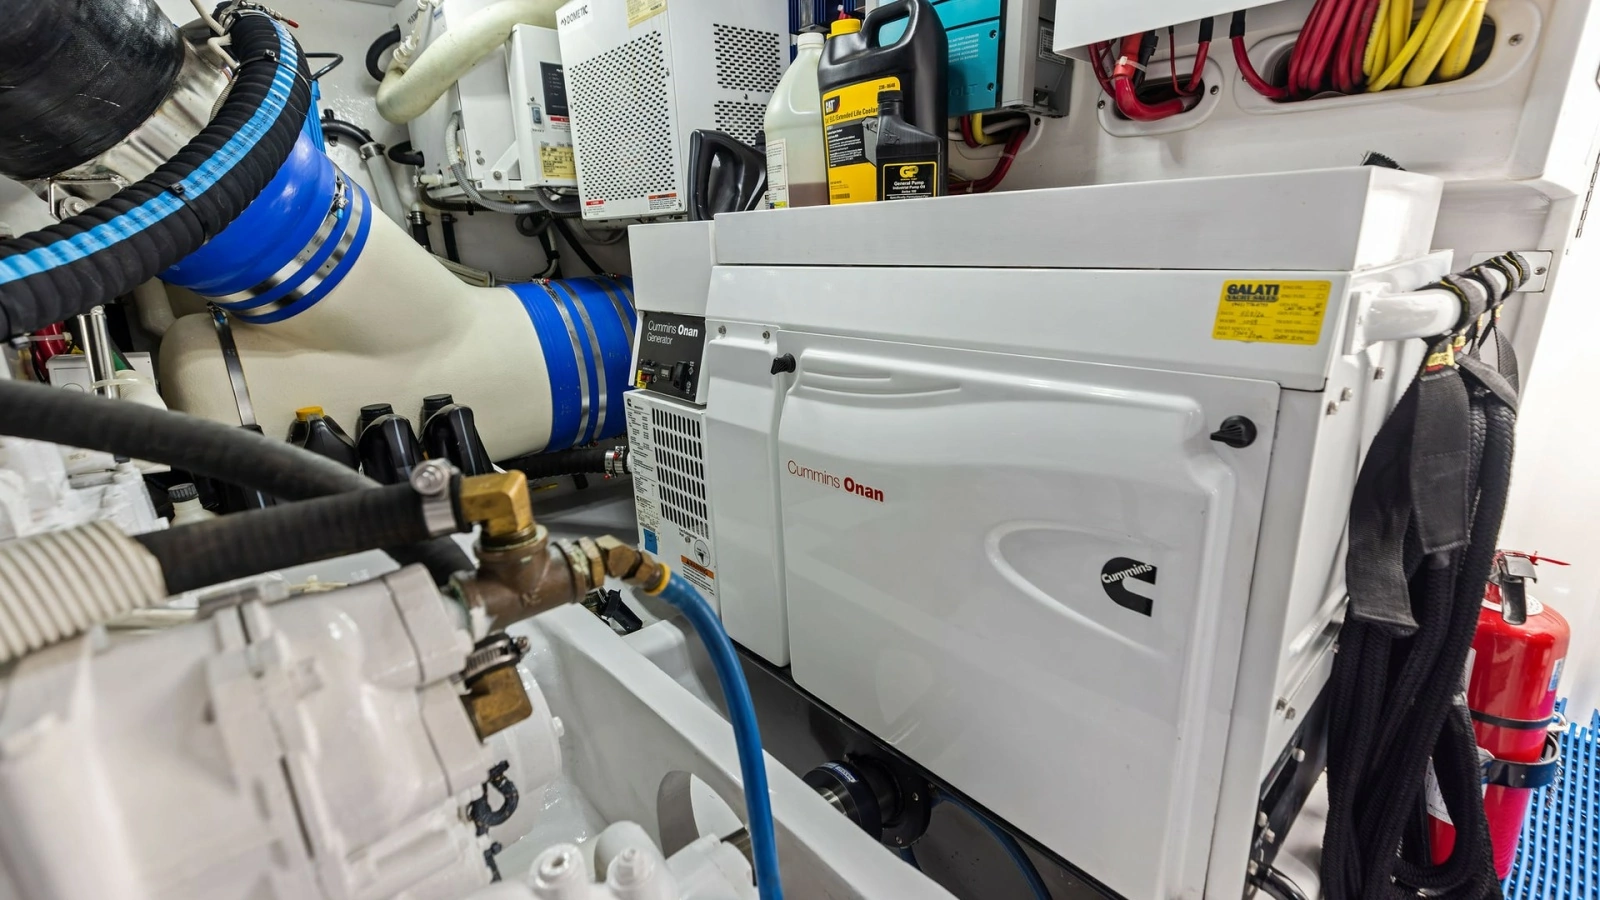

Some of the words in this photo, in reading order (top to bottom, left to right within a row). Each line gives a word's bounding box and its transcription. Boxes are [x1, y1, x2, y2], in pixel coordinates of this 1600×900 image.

[566, 4, 589, 25] DOMETIC
[825, 99, 836, 114] CAT
[862, 107, 878, 115] Coolan
[1227, 284, 1280, 295] GALATI
[648, 320, 677, 334] Cummins
[677, 324, 698, 337] Onan
[646, 332, 673, 345] Generator
[787, 459, 841, 489] Cummins
[843, 476, 884, 502] Onan
[1101, 563, 1153, 584] Cummins
